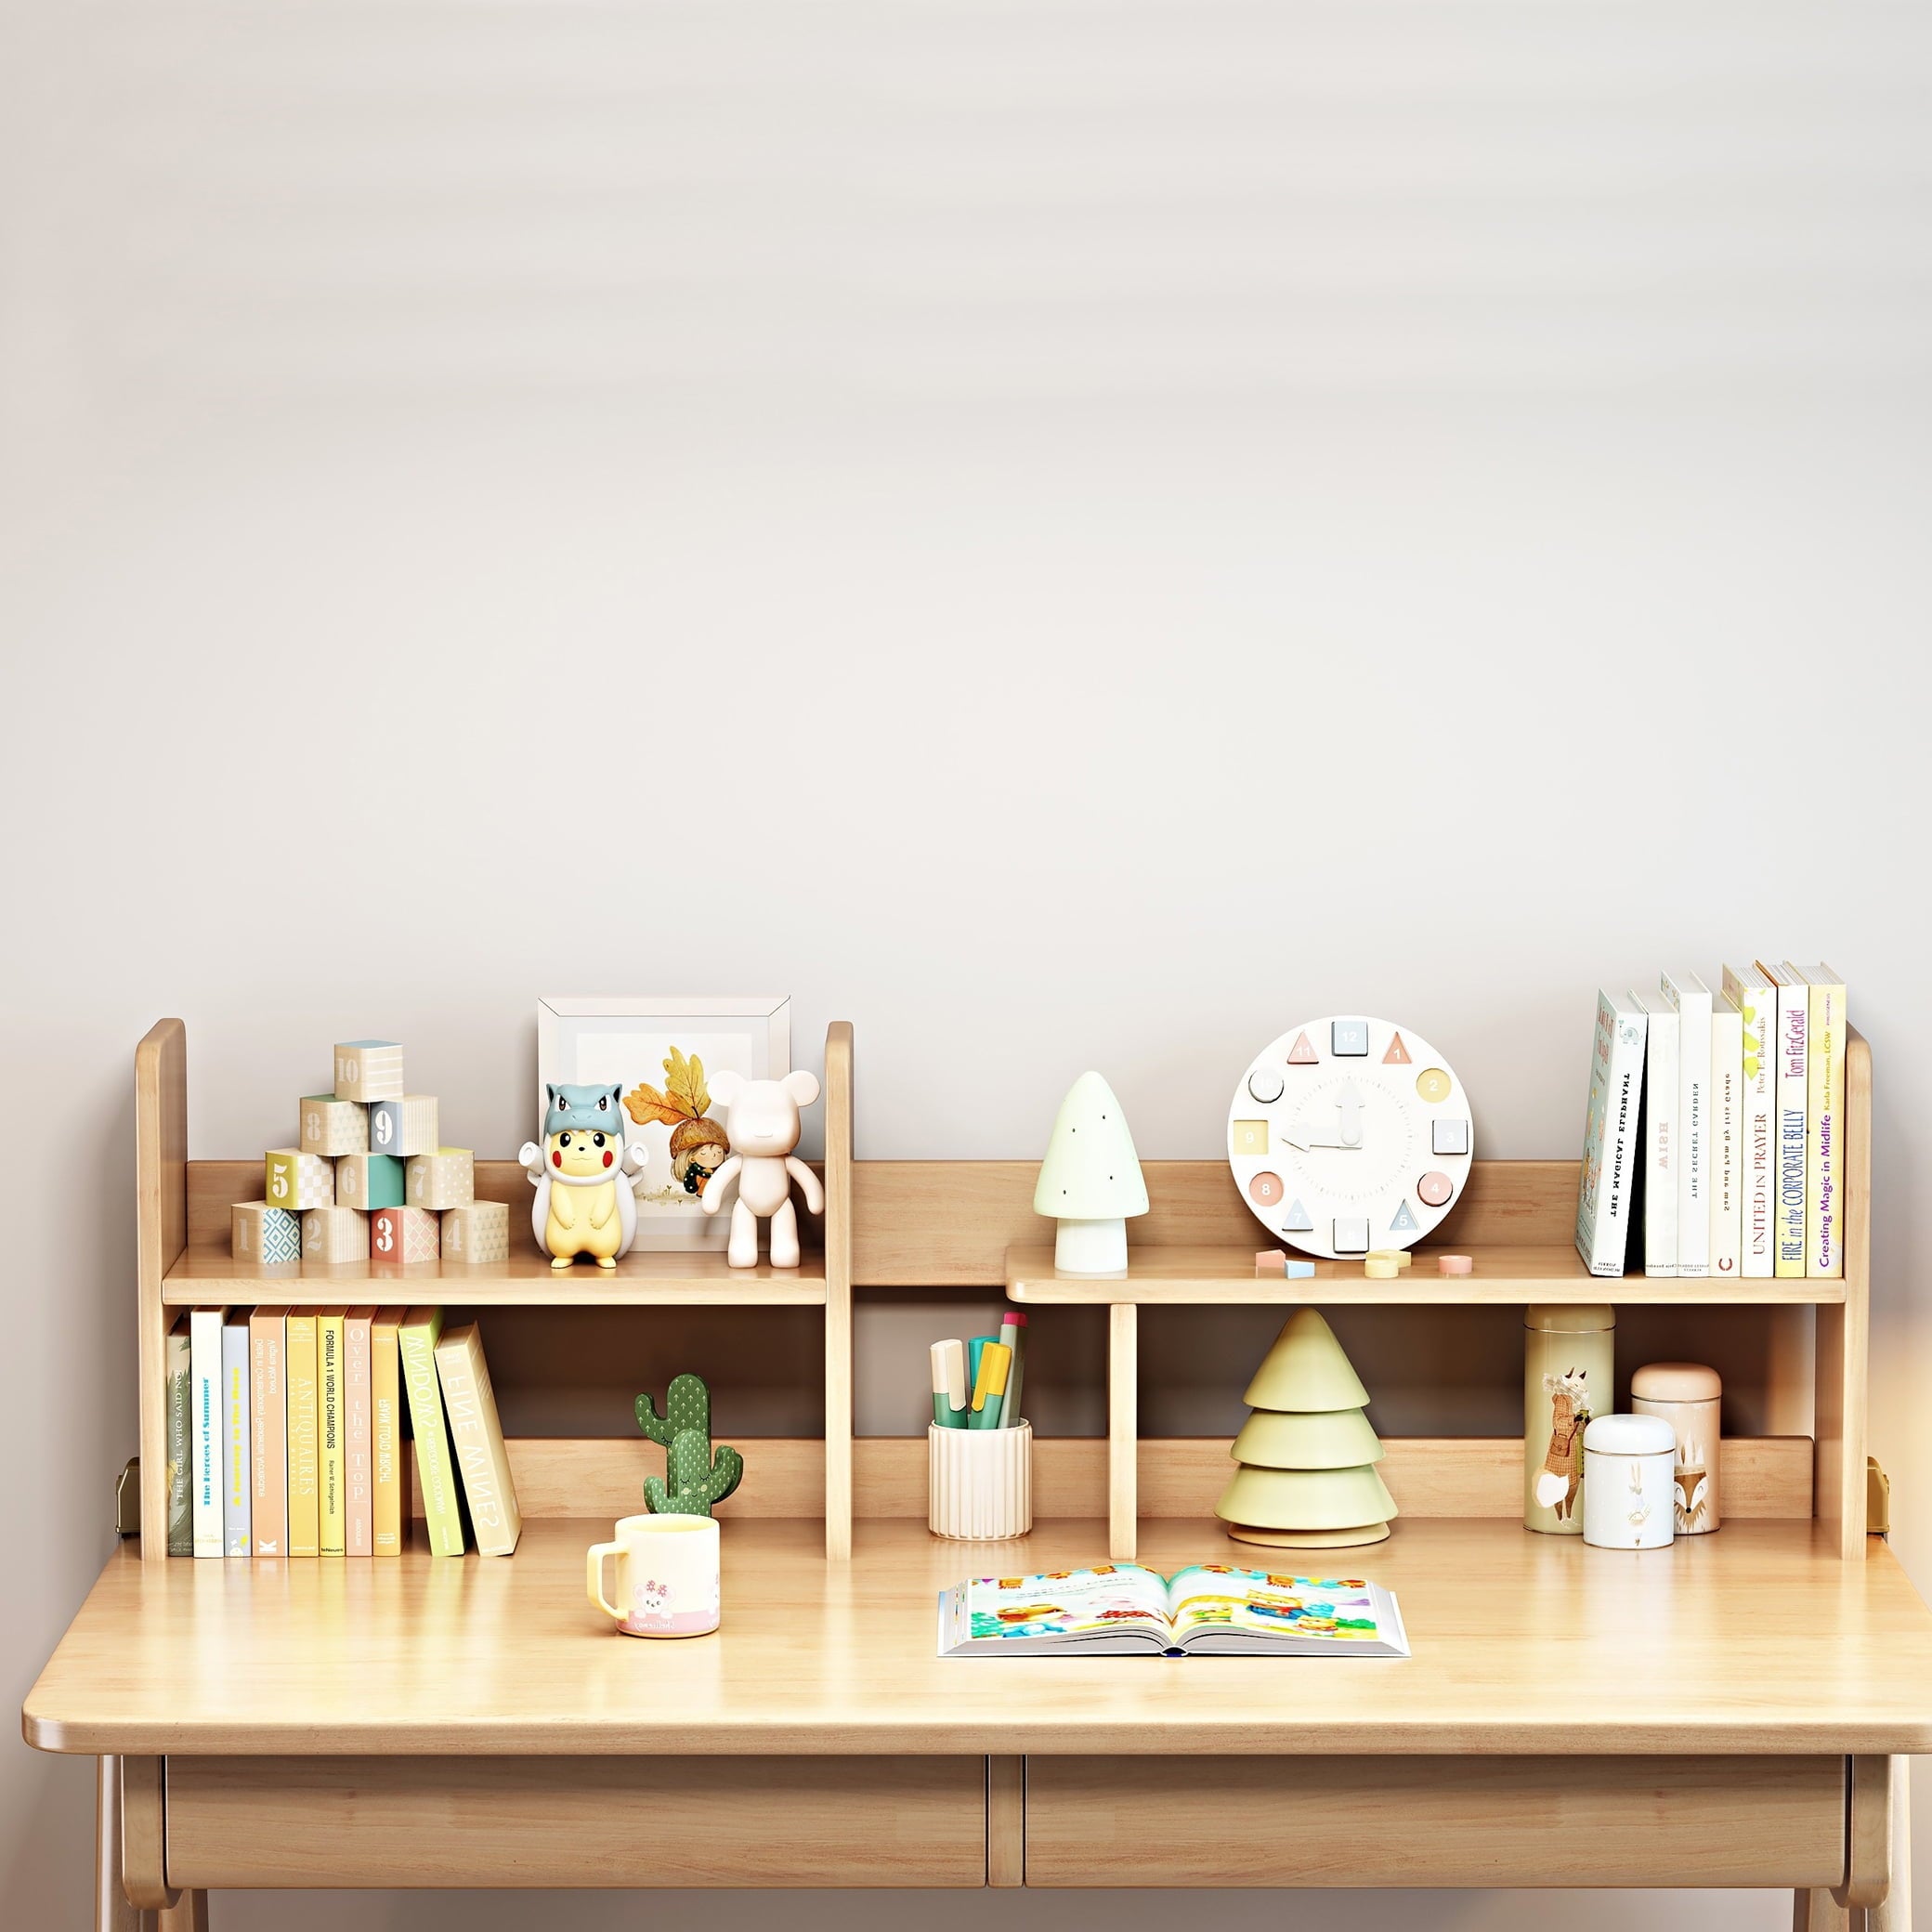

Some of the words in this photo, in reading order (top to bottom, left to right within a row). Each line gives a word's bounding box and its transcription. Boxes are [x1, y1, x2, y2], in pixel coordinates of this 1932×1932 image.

[1342, 1031, 1357, 1042] 12
[1756, 1017, 1766, 1058] Roussakis
[1785, 1011, 1805, 1055] FitzGerald
[1297, 1046, 1311, 1056] 11
[1393, 1049, 1401, 1059] 1
[337, 1058, 359, 1084] 10
[1785, 1058, 1804, 1078] Tom
[1429, 1079, 1438, 1090] 2
[1756, 1073, 1765, 1093] Peter
[307, 1113, 320, 1142] 8
[375, 1110, 393, 1145] 9
[1246, 1132, 1254, 1143] 9
[1446, 1131, 1455, 1142] 3
[1783, 1109, 1804, 1140] BELLY
[1821, 1115, 1831, 1156] Midlife
[1754, 1114, 1767, 1169] PRAYER
[272, 1163, 288, 1198] 5
[342, 1166, 357, 1195] 6
[411, 1165, 426, 1196] 7
[1756, 1175, 1766, 1187] IN
[1782, 1144, 1803, 1206] CORPORATE
[1821, 1161, 1830, 1172] in
[1261, 1184, 1270, 1195] 8
[1430, 1182, 1440, 1193] 4
[1821, 1175, 1833, 1211] Magic
[1294, 1212, 1302, 1223] 7
[1399, 1215, 1408, 1227] 5
[1753, 1192, 1766, 1255] UNITED
[1781, 1209, 1803, 1225] the
[238, 1218, 249, 1251] 1
[307, 1218, 322, 1252] 2
[376, 1217, 393, 1252] 3
[445, 1218, 462, 1252] 4
[1782, 1228, 1802, 1237] in
[1820, 1215, 1832, 1267] Creating
[1782, 1241, 1802, 1260] FIRE
[325, 1330, 334, 1367] FORMULA
[349, 1328, 364, 1382] Over
[326, 1374, 335, 1403] WORLD
[202, 1430, 209, 1442] of
[295, 1377, 313, 1495] ANTIQUAIRES
[326, 1403, 335, 1449] CHAMPIONS
